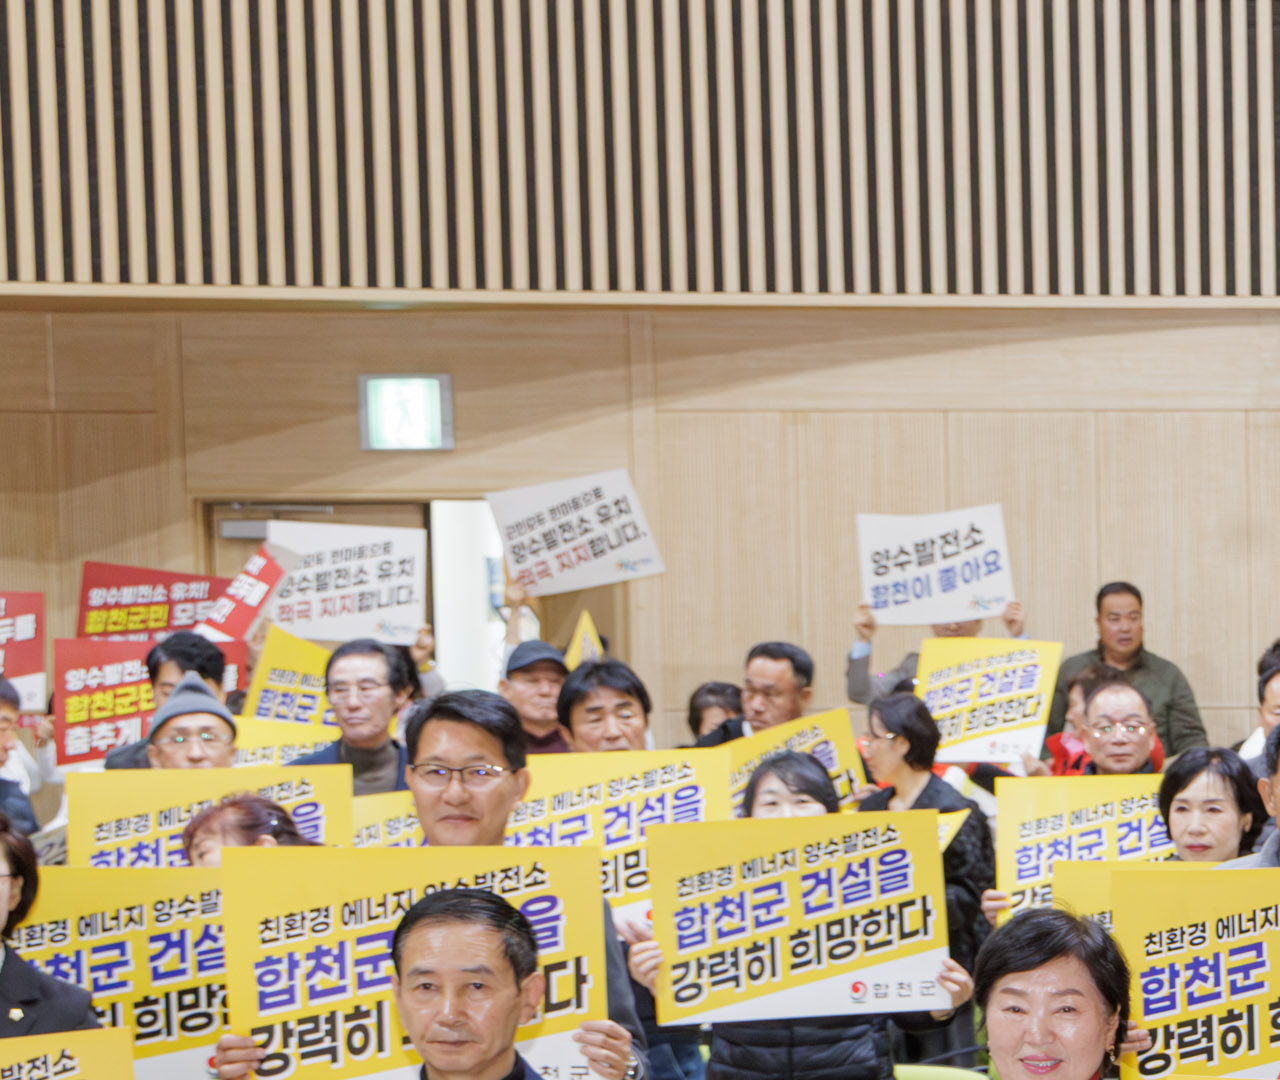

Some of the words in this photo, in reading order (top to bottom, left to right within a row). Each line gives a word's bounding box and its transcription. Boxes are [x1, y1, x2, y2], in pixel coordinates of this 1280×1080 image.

[511, 516, 594, 565] 양수발전소
[595, 496, 634, 528] 유치
[870, 523, 984, 577] 양수발전소
[278, 562, 375, 600] 양수발전소
[378, 556, 416, 580] 유치
[552, 783, 601, 811] 에너지
[608, 761, 696, 798] 양수발전소
[603, 785, 704, 845] 건설을
[94, 814, 153, 843] 친환경
[1018, 812, 1066, 841] 친환경
[1070, 802, 1116, 827] 에너지
[677, 865, 736, 900] 친환경
[741, 849, 799, 881] 에너지
[804, 824, 901, 865] 양수발전소
[78, 904, 146, 940] 에너지
[259, 908, 333, 948] 친환경
[342, 891, 417, 930] 에너지
[675, 881, 790, 952] 합천군
[801, 849, 914, 917] 건설을
[671, 936, 782, 1005] 강력히
[790, 895, 937, 971] 희망한다
[1144, 922, 1209, 959] 친환경
[1216, 905, 1280, 942] 에너지
[254, 930, 394, 1017] 합천군
[1140, 942, 1270, 1021] 합천군
[252, 1000, 390, 1080] 강력히
[1137, 1004, 1260, 1079] 강력히
